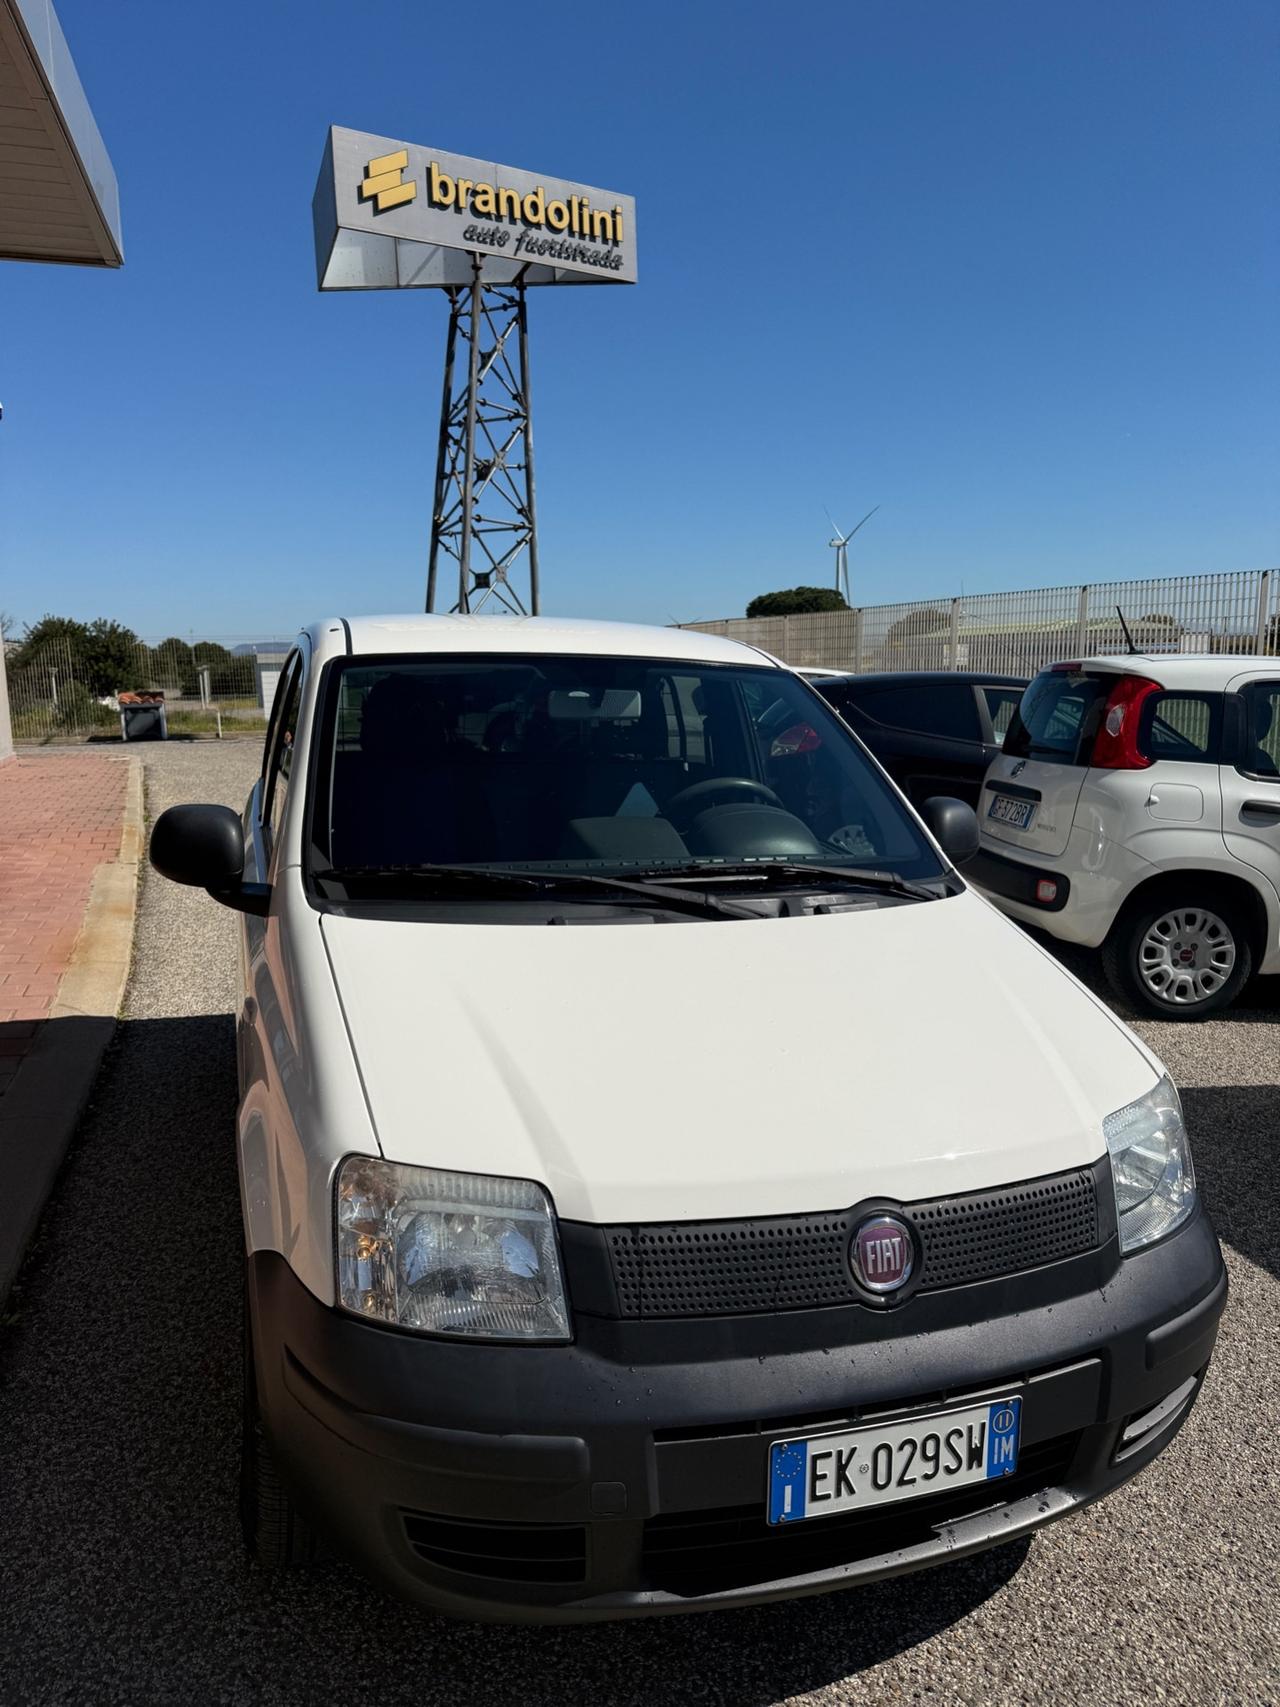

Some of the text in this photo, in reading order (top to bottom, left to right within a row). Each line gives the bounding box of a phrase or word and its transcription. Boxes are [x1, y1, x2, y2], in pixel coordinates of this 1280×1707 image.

[429, 161, 624, 243] brandolini
[463, 223, 625, 271] auto fuoristrada
[866, 1237, 902, 1274] FIAT
[809, 1445, 858, 1503] EK
[870, 1420, 987, 1491] 029SW
[993, 1433, 1015, 1465] IM
